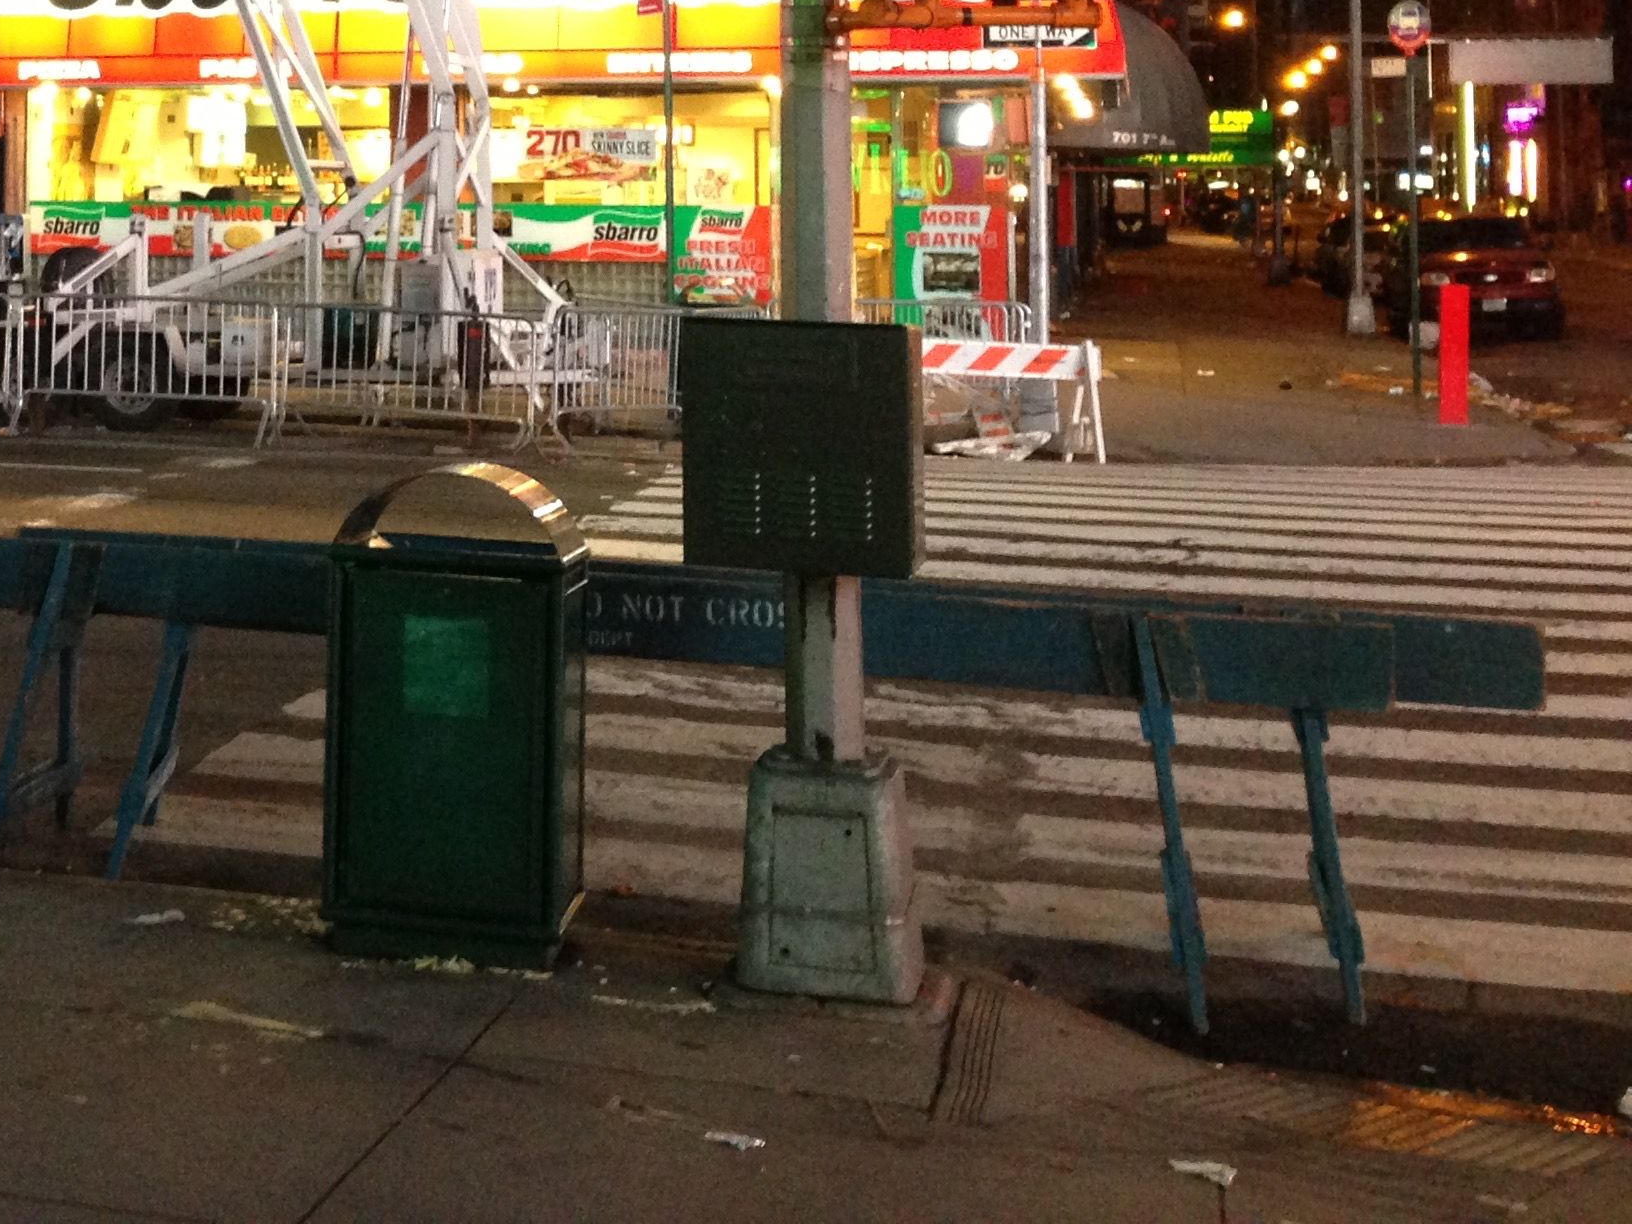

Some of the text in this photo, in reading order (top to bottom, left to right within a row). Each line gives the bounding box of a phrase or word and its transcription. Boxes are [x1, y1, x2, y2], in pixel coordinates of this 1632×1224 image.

[998, 25, 1077, 40] ONE WAY
[526, 129, 581, 156] 270
[1112, 130, 1137, 145] 701
[591, 140, 652, 156] SKINNY SLICE
[177, 205, 265, 221] ITALIAN
[920, 210, 982, 225] MORE
[42, 215, 101, 235] sbarro
[700, 215, 743, 228] sbarro
[593, 221, 659, 242] sbarro
[905, 231, 998, 248] SEATING
[686, 239, 757, 254] FRESH
[677, 256, 766, 273] ITALIAN
[621, 593, 685, 622] NOT
